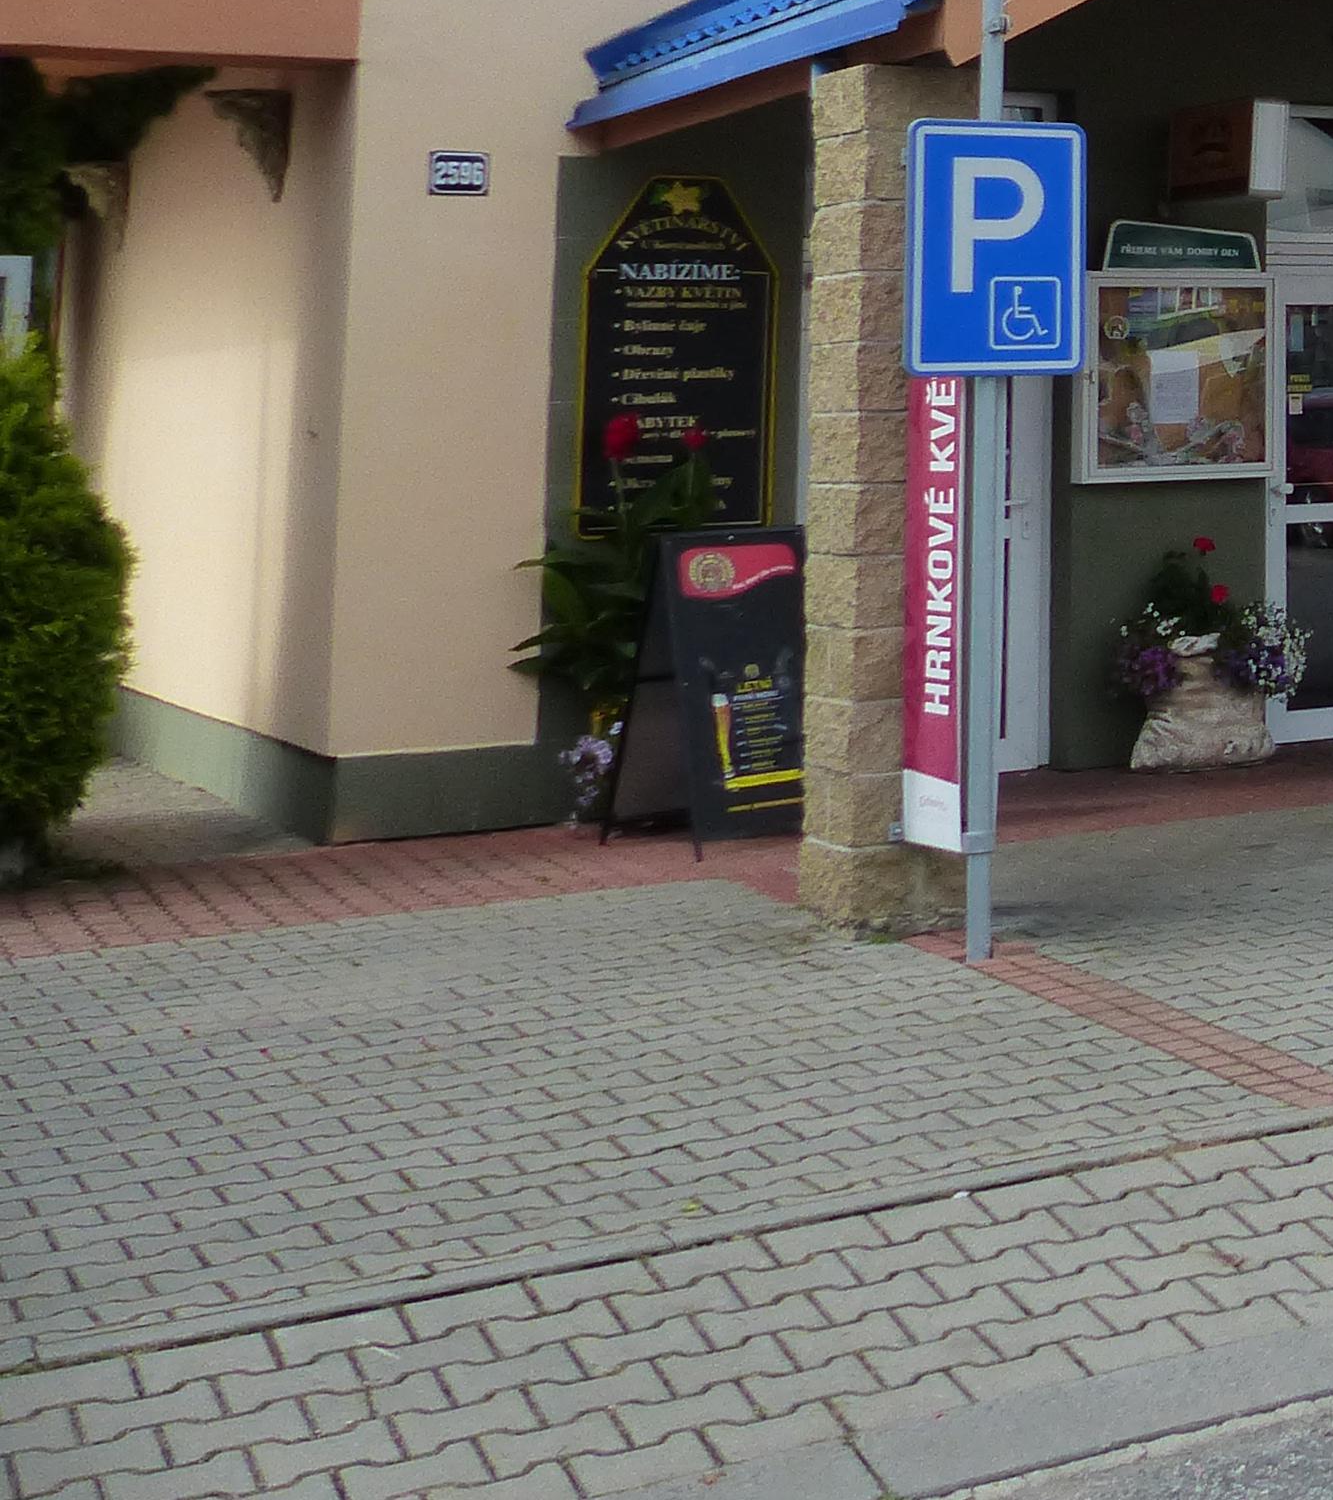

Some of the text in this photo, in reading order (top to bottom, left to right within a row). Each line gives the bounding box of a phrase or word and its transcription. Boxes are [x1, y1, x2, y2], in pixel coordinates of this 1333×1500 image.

[435, 162, 484, 185] 2596
[952, 157, 1044, 292] P
[923, 376, 957, 716] HRNKOVÉ KVĚ
